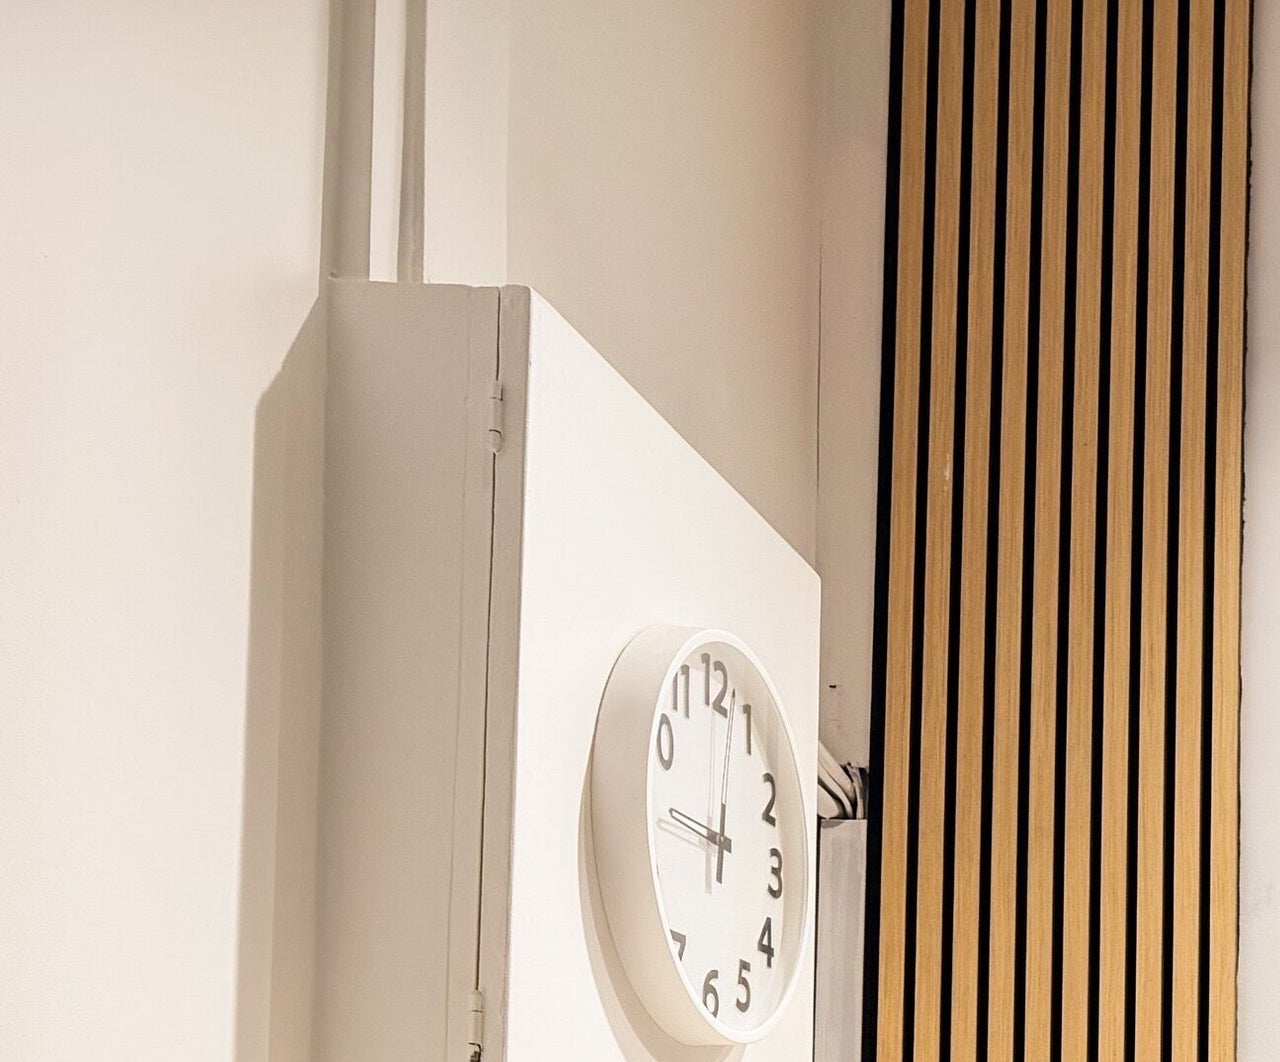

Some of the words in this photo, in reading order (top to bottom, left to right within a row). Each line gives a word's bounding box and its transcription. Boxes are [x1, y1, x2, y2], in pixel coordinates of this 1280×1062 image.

[673, 664, 690, 719] 11
[700, 652, 728, 718] 12
[656, 713, 674, 770] 0
[742, 703, 752, 756] 1
[762, 772, 777, 828] 2
[767, 847, 783, 899] 3
[757, 916, 775, 968] 4
[702, 969, 719, 1018] 6
[736, 958, 751, 1013] 5
